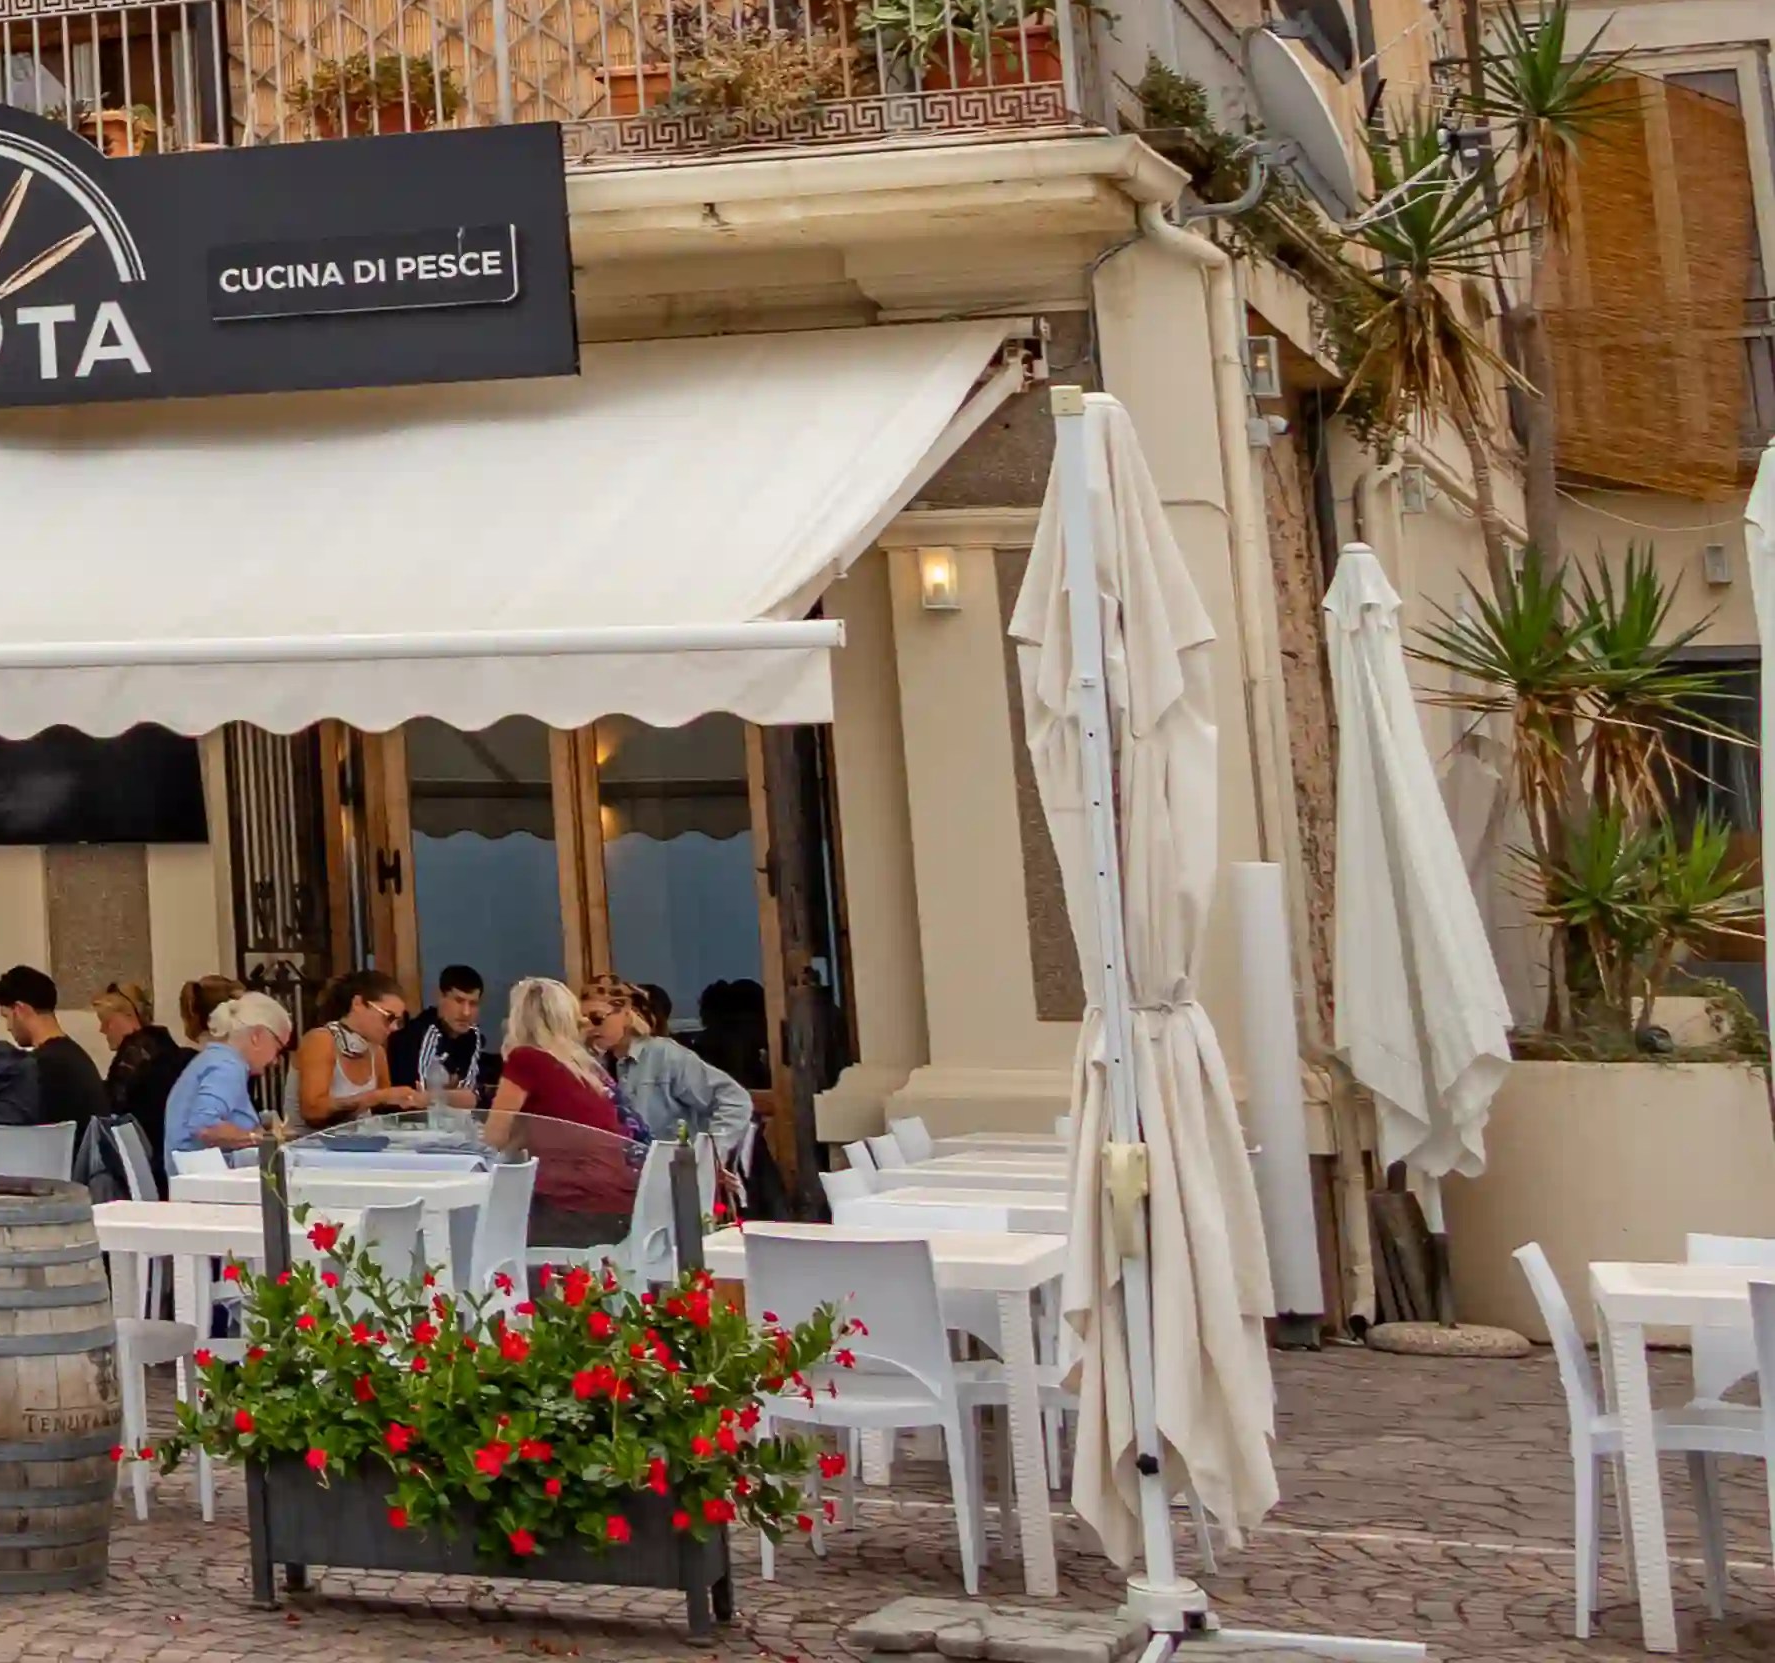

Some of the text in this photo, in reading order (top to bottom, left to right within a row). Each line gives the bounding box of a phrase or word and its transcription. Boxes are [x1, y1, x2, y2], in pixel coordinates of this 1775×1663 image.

[219, 251, 502, 293] CUCINA DI PESCE
